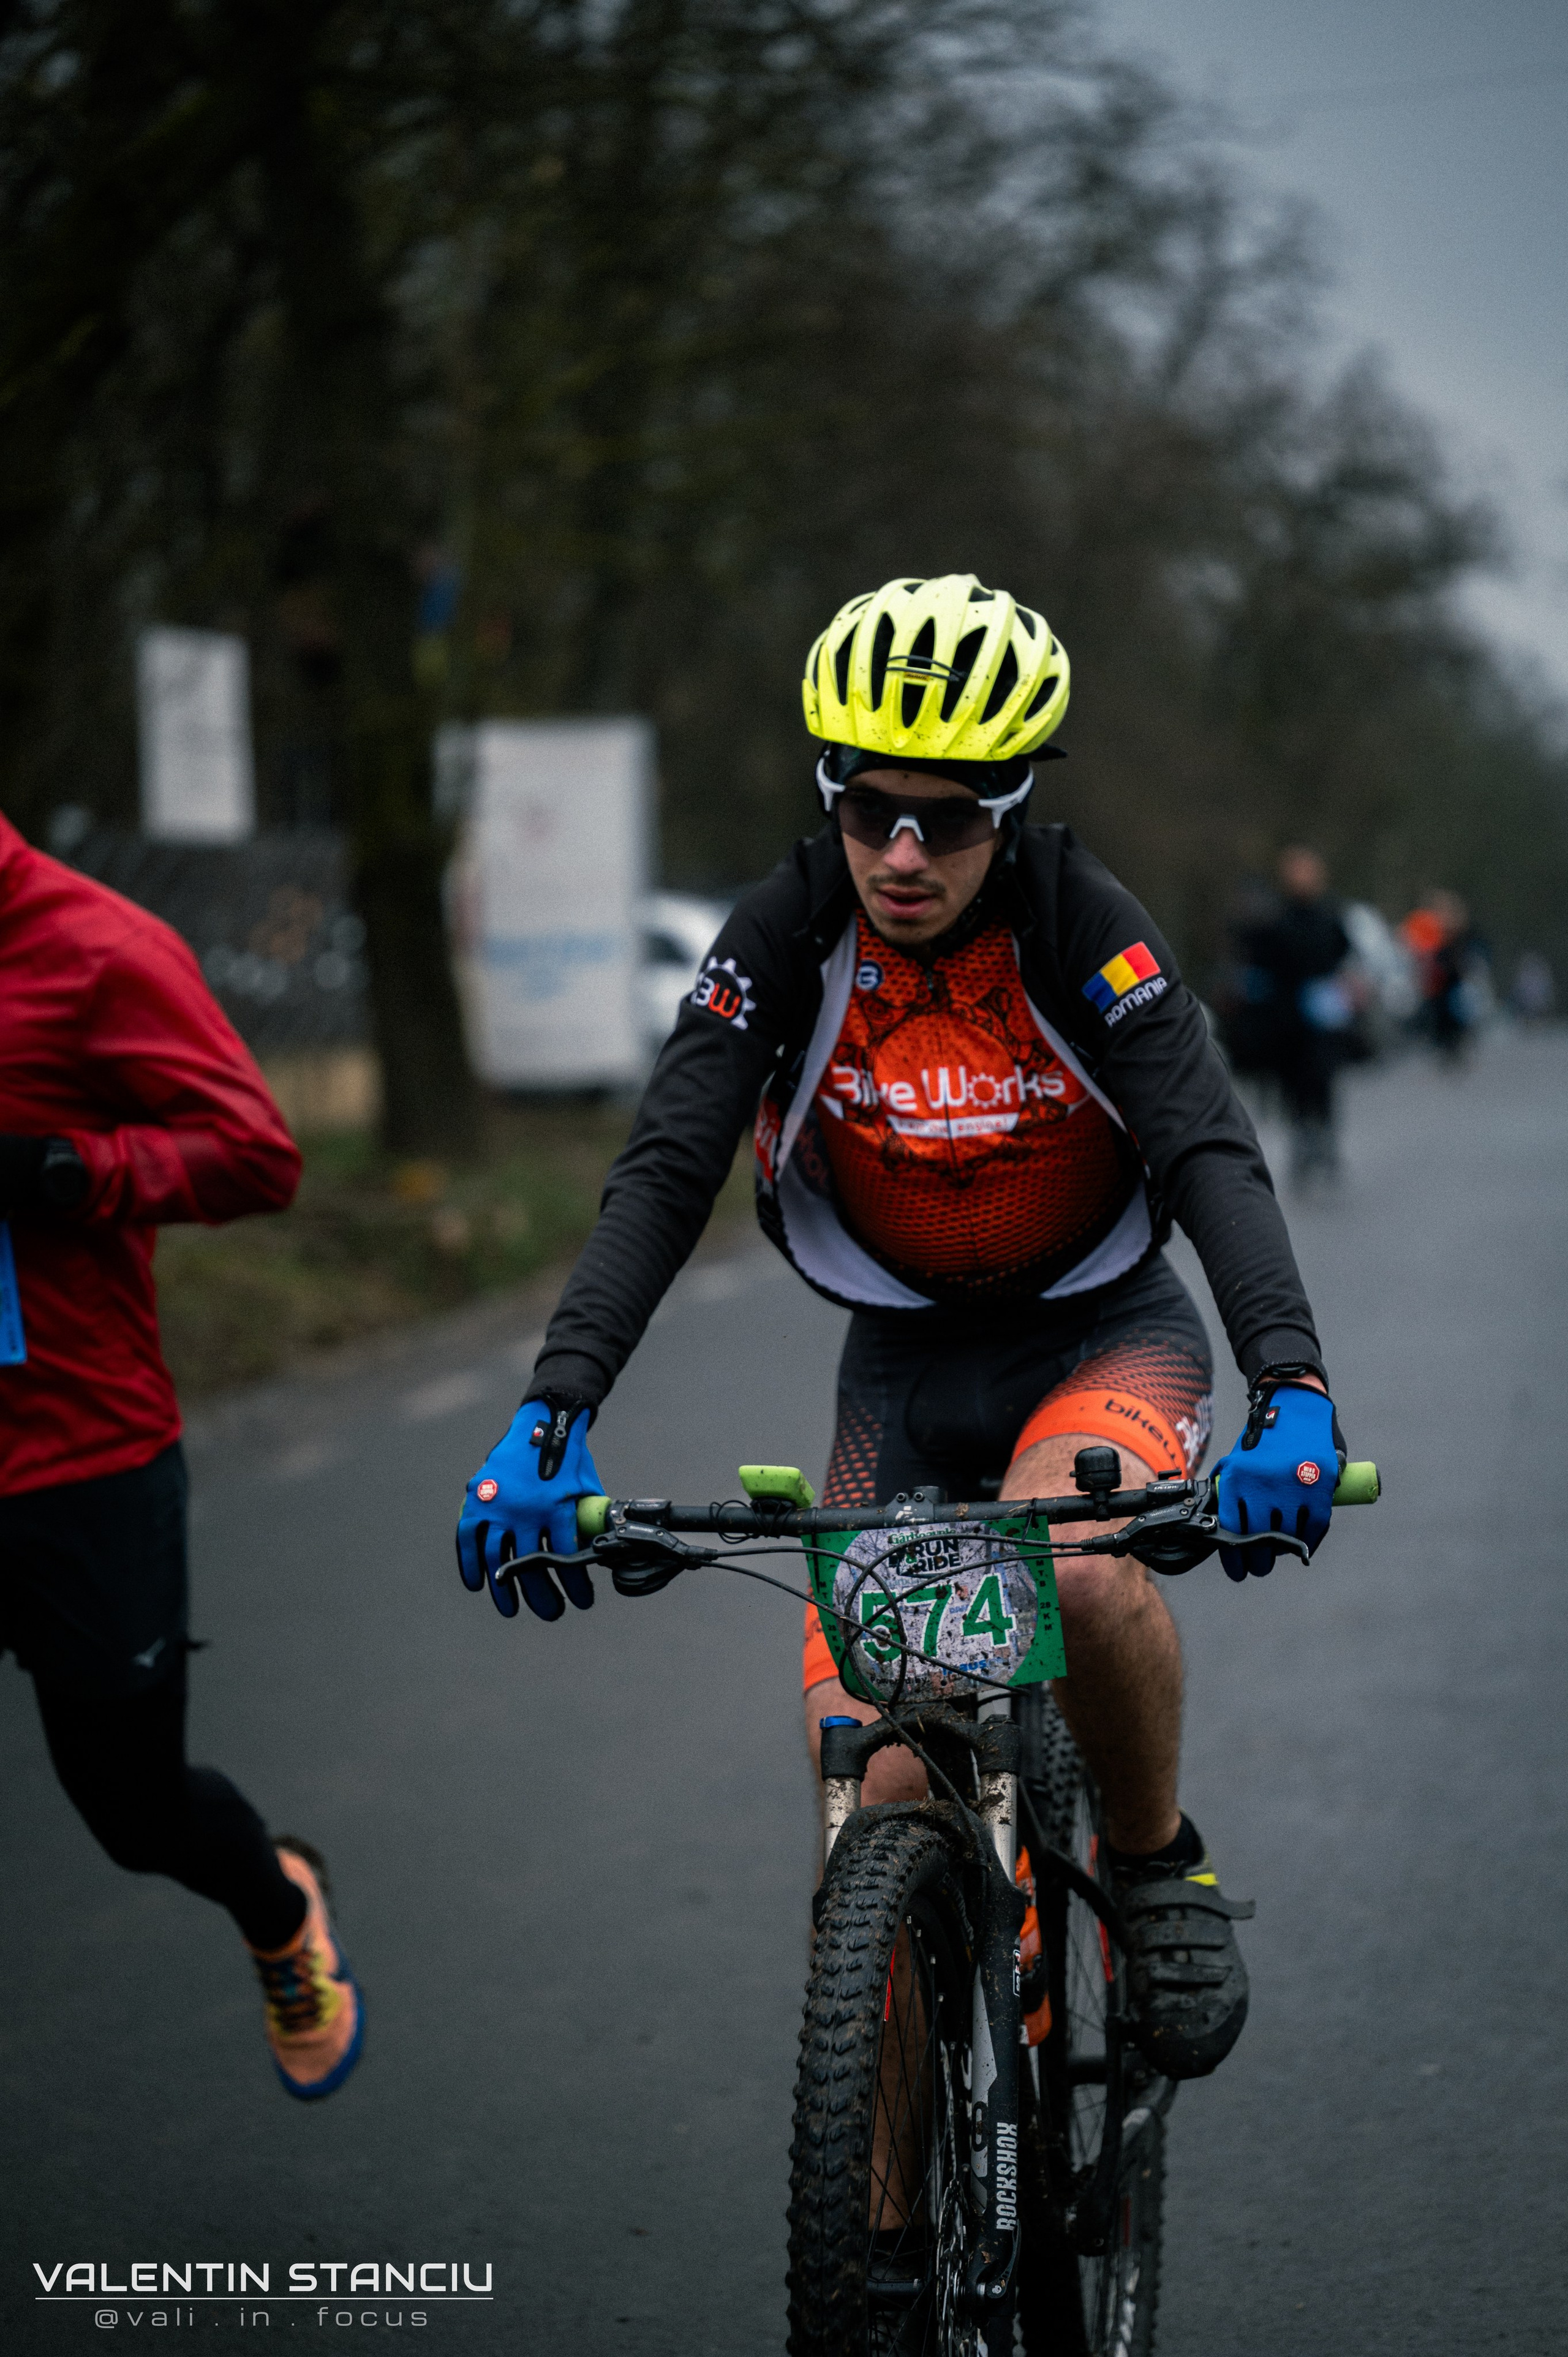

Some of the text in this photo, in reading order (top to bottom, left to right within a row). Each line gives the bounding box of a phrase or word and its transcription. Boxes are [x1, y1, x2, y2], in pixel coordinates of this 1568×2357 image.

[1104, 977, 1167, 1028] ROMANIA
[832, 1065, 1066, 1112] Bike Works
[912, 1538, 960, 1558] RUN
[913, 1552, 962, 1572] RIDE
[860, 1572, 1017, 1665] 574
[996, 2122, 1018, 2231] ROCKSHOX
